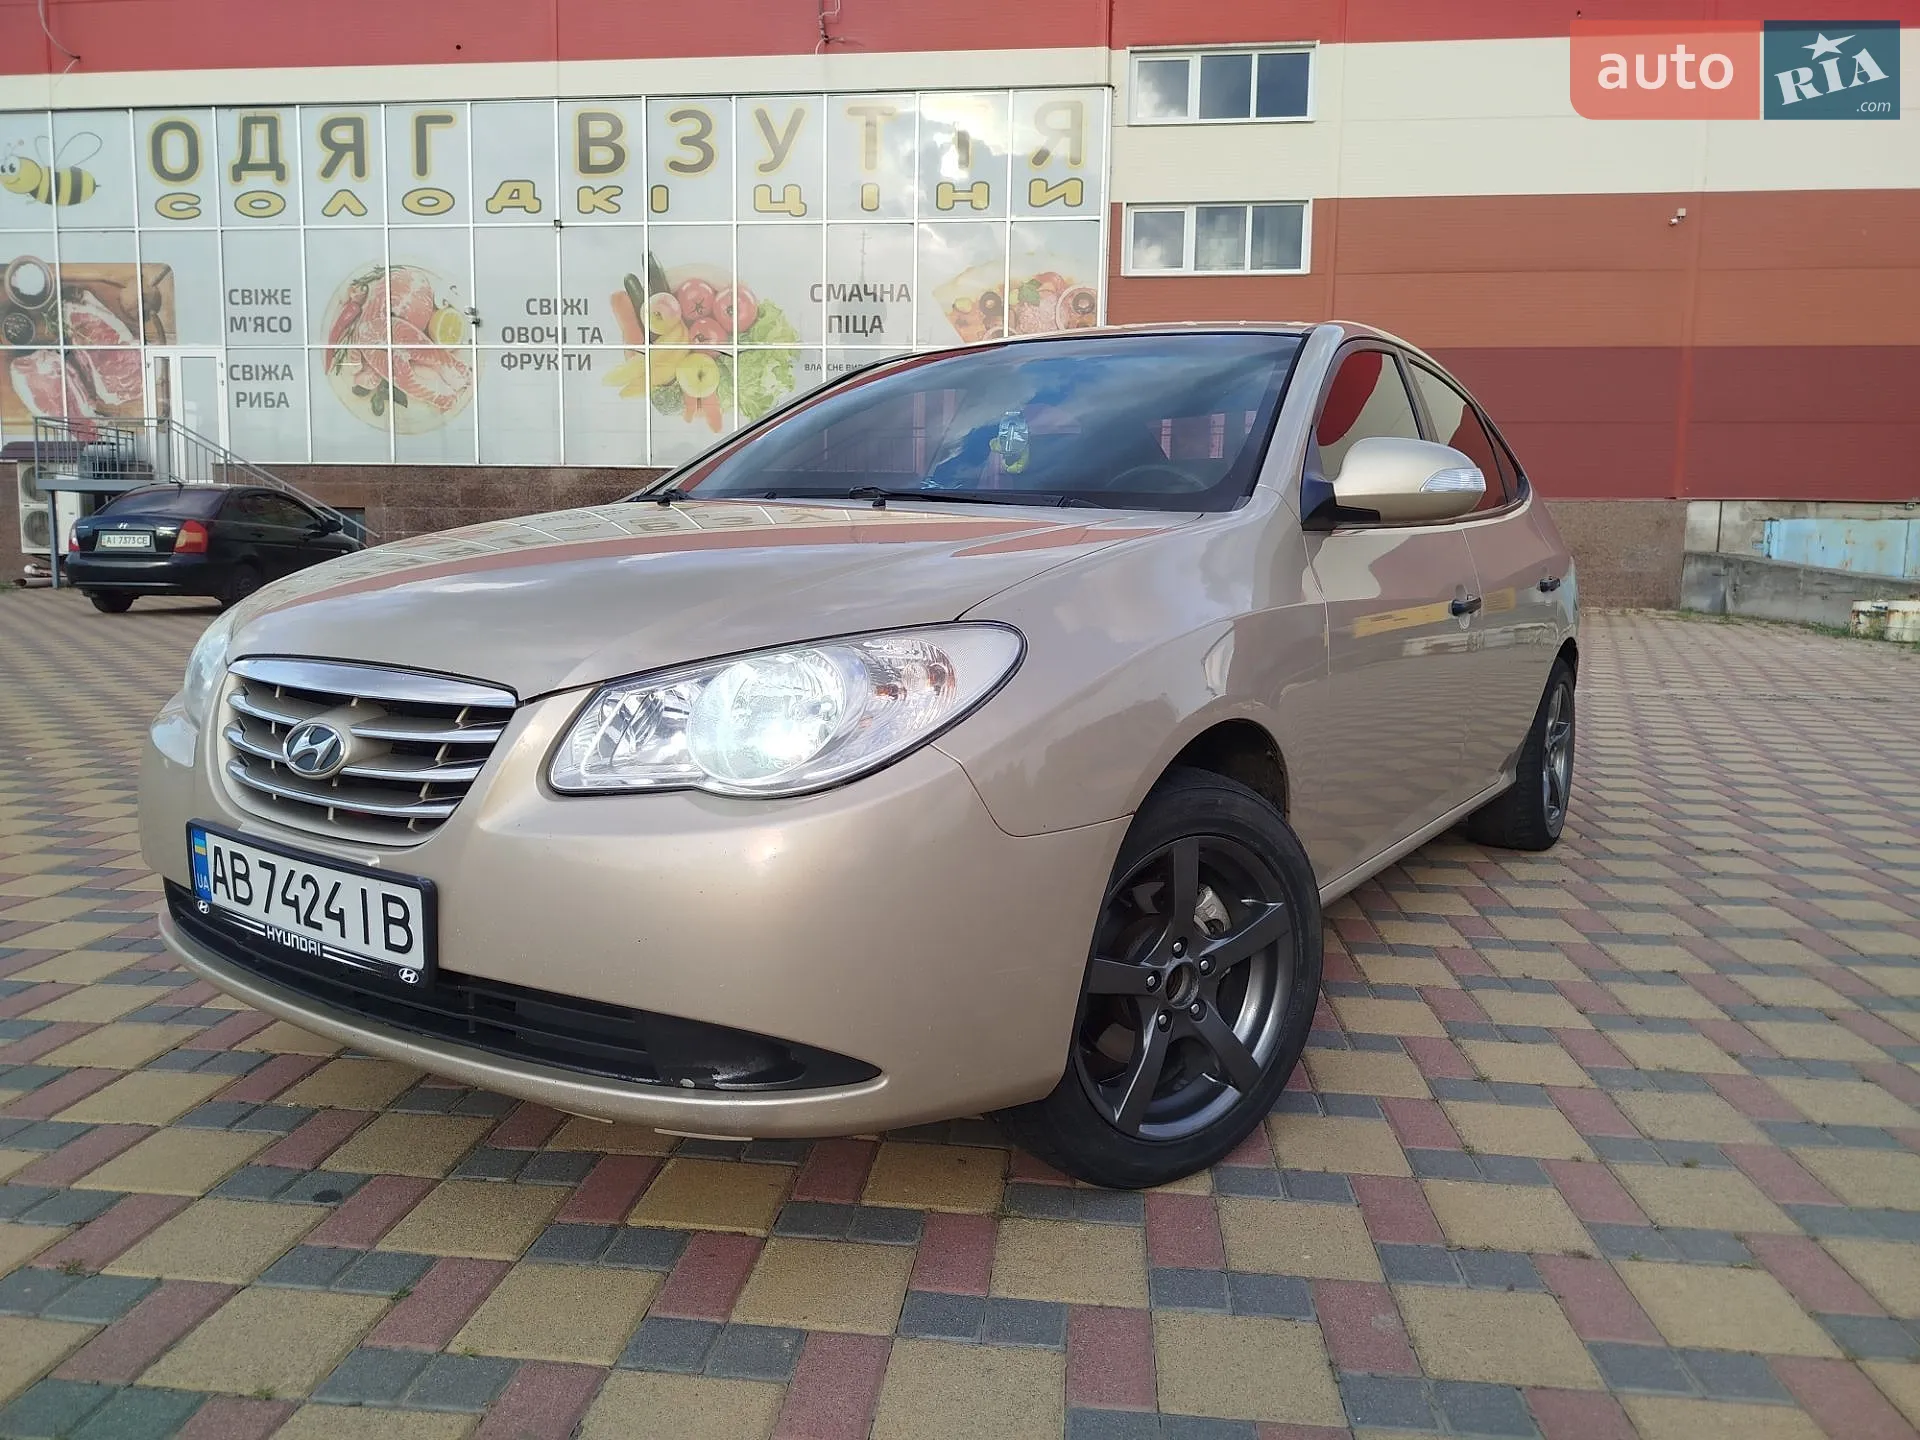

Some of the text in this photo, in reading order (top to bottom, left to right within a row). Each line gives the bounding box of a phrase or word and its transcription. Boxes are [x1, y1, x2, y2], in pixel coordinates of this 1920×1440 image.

[149, 110, 456, 184] ОДЯГ
[154, 177, 1084, 220] СОЛОДКІ ЦІНИ
[228, 288, 292, 305] СВІЖЕ
[809, 283, 912, 303] СМАЧНА
[526, 298, 588, 315] СВІЖІ
[230, 316, 292, 333] М'ЯСО
[828, 315, 885, 337] ПІЦА
[501, 326, 604, 344] ОВОЧІ ТА
[500, 351, 592, 371] ФРУКТИ
[229, 364, 294, 381] СВІЖА
[236, 391, 290, 408] РИБА
[197, 873, 209, 891] UA
[266, 926, 322, 957] HYUNDAI
